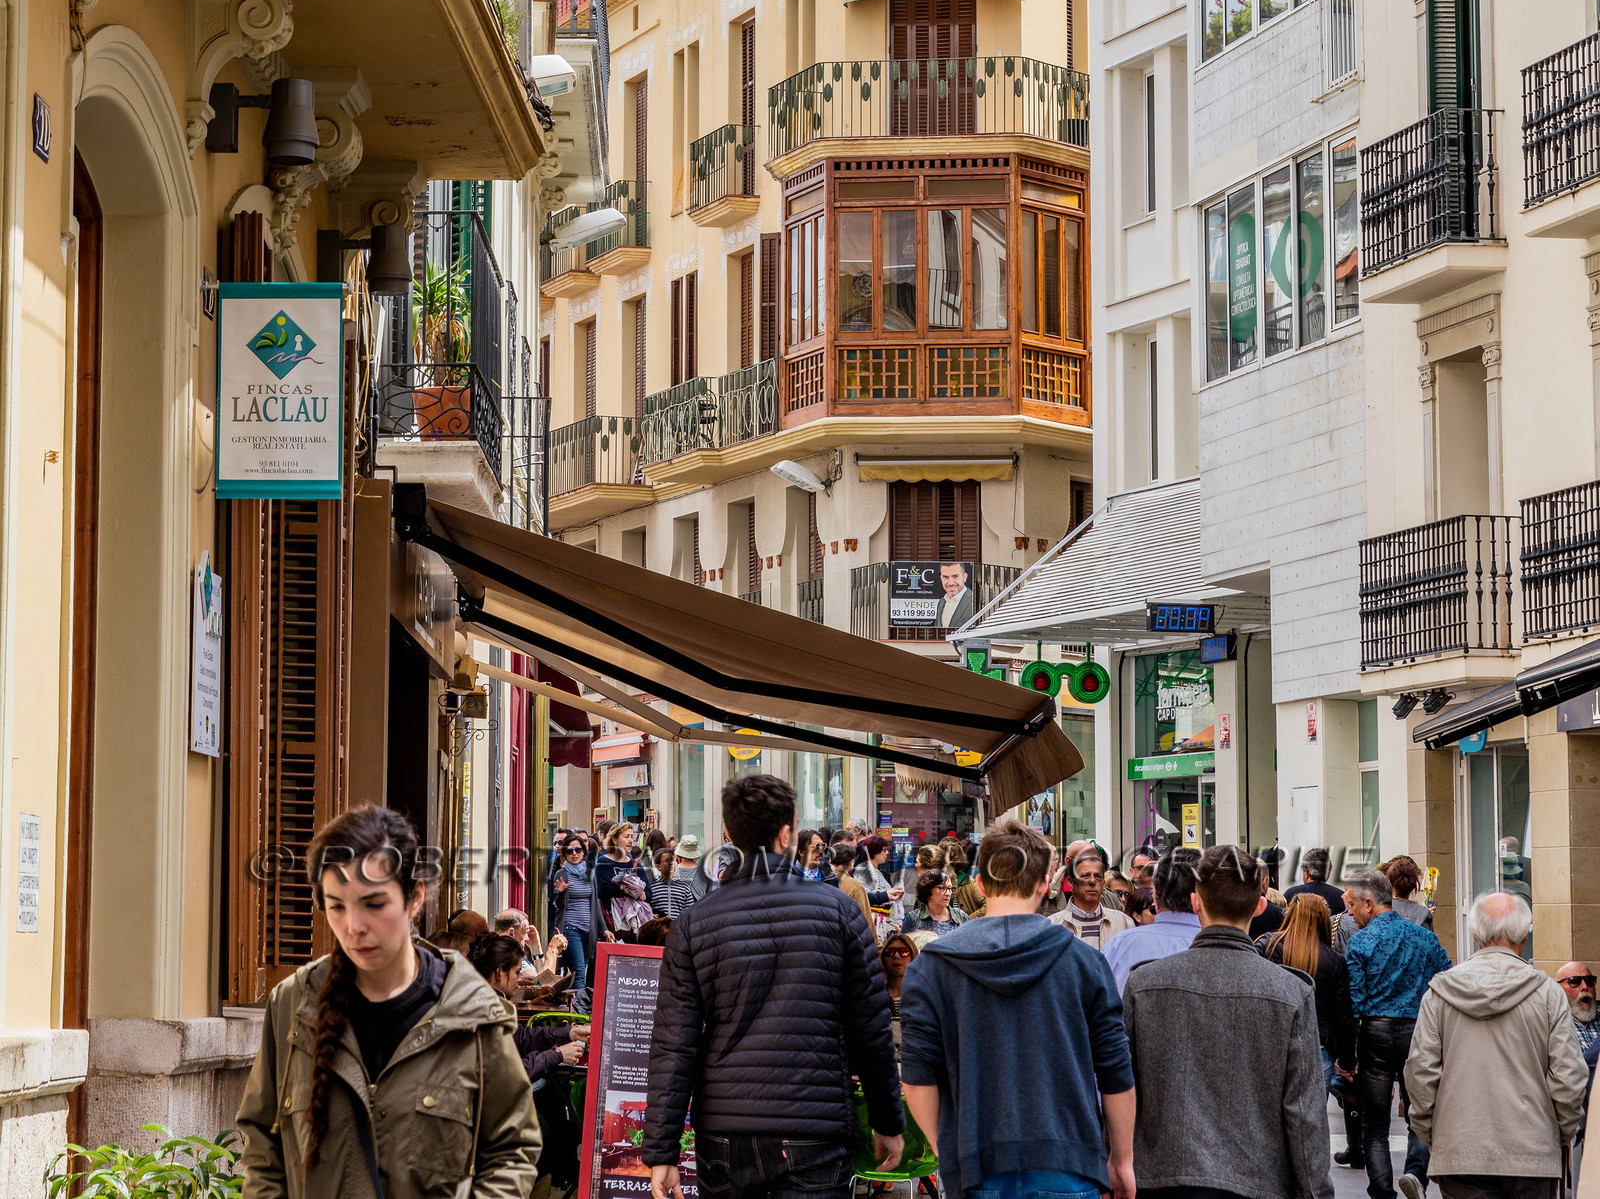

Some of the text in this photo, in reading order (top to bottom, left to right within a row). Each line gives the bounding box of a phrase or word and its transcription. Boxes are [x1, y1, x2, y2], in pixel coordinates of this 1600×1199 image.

[39, 105, 50, 151] 10
[246, 384, 313, 394] FINCAS
[232, 396, 328, 422] LACLAU
[232, 434, 268, 443] GESTIÓN
[618, 977, 648, 987] MEDIO
